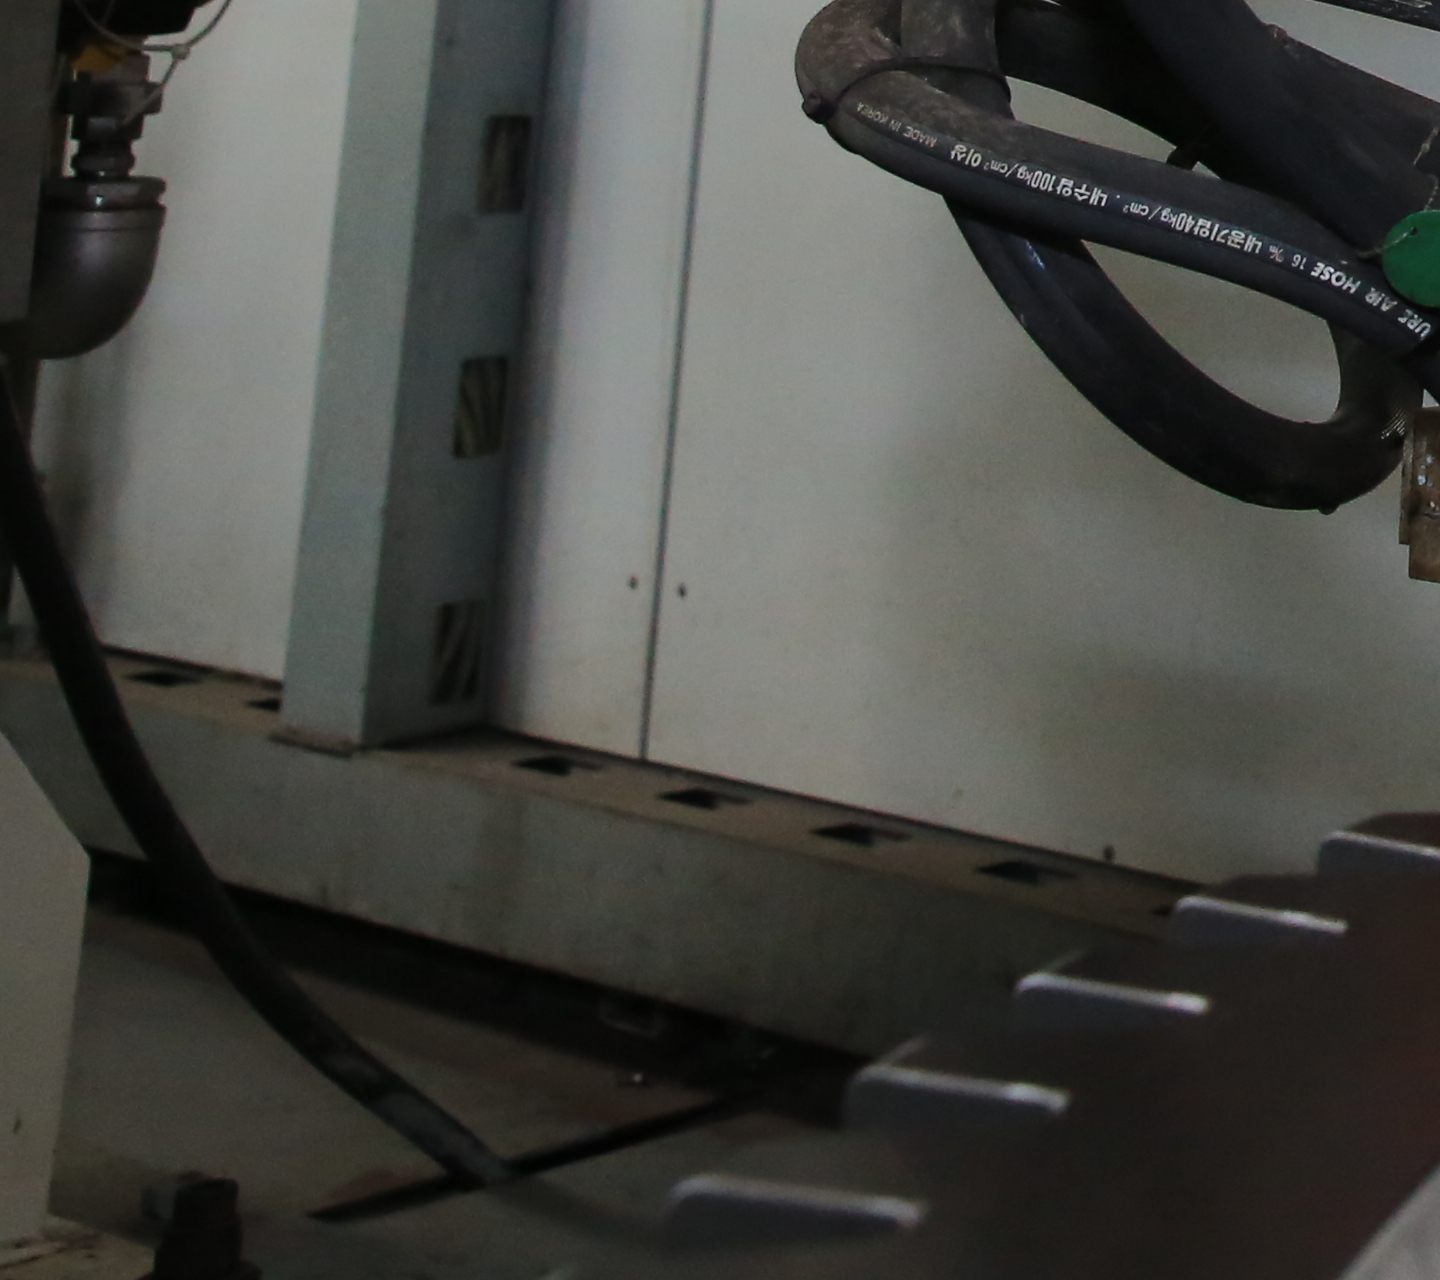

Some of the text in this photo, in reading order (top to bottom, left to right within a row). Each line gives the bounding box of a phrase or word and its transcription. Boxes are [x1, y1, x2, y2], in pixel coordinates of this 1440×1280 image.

[857, 101, 889, 125] KOREA
[888, 117, 902, 133] IN
[902, 125, 938, 148] MADE
[1291, 254, 1307, 271] 16
[1310, 261, 1362, 294] HOSE
[1364, 287, 1398, 312] AIR
